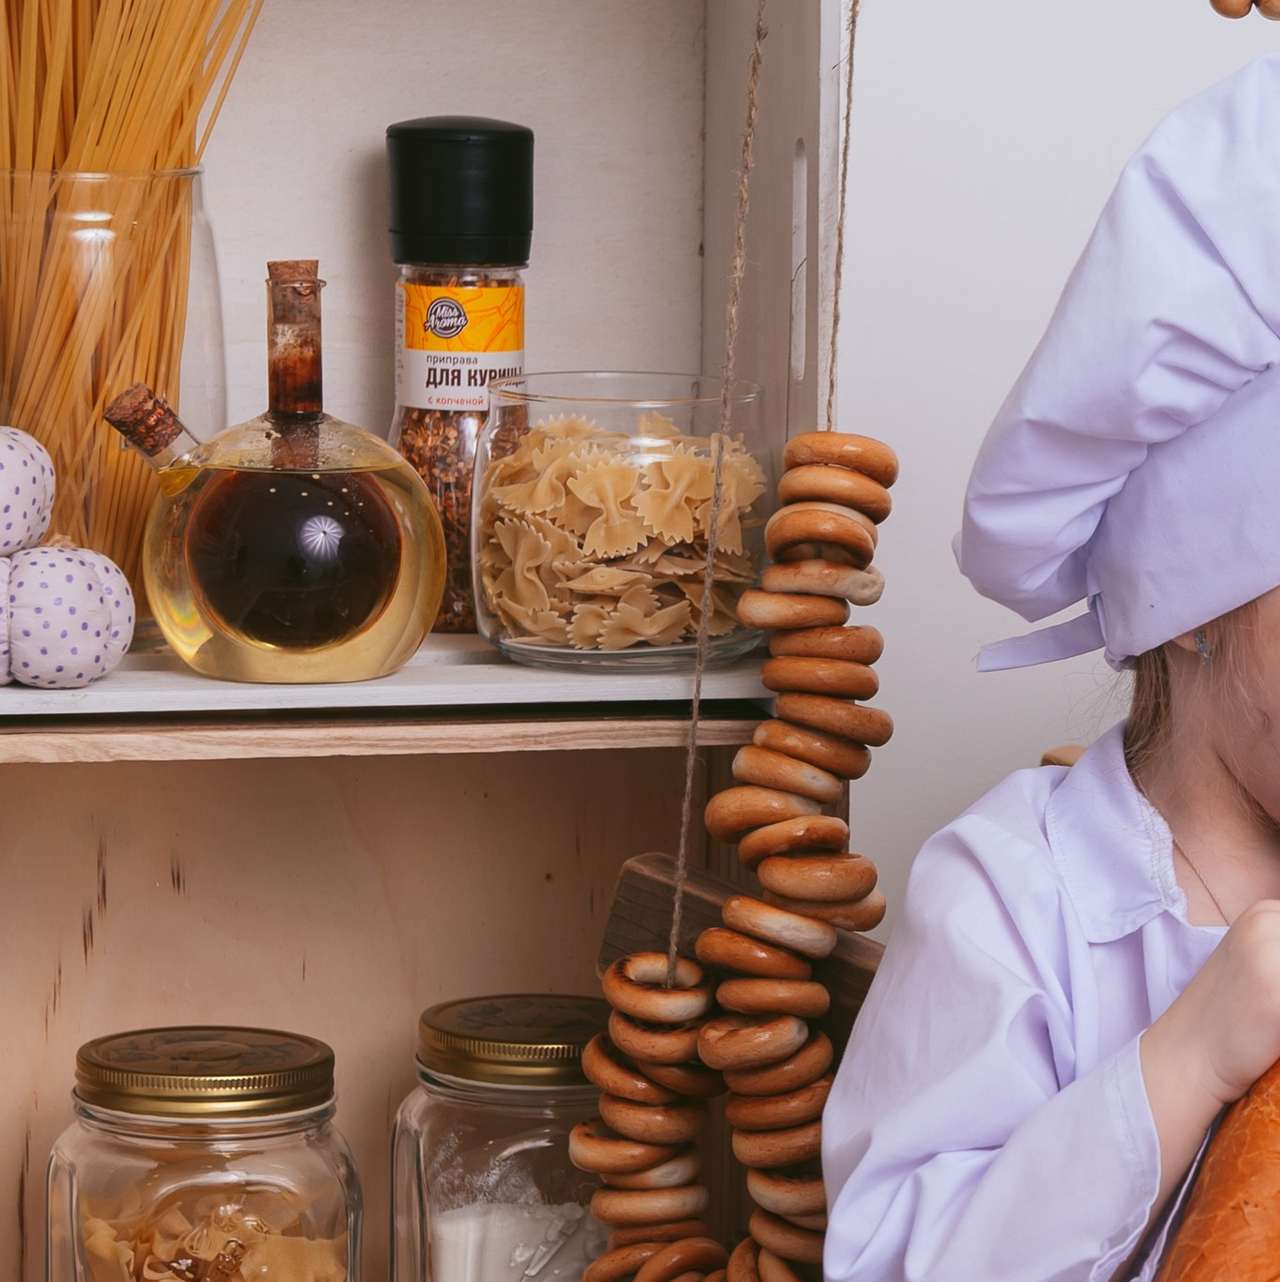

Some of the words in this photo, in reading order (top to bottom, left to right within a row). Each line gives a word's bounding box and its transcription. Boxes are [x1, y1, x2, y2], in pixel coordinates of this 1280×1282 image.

[435, 305, 459, 318] Miss
[424, 314, 467, 330] Aroma
[426, 354, 478, 366] приправа
[425, 367, 461, 388] ДЛЯ
[435, 396, 484, 406] копченой
